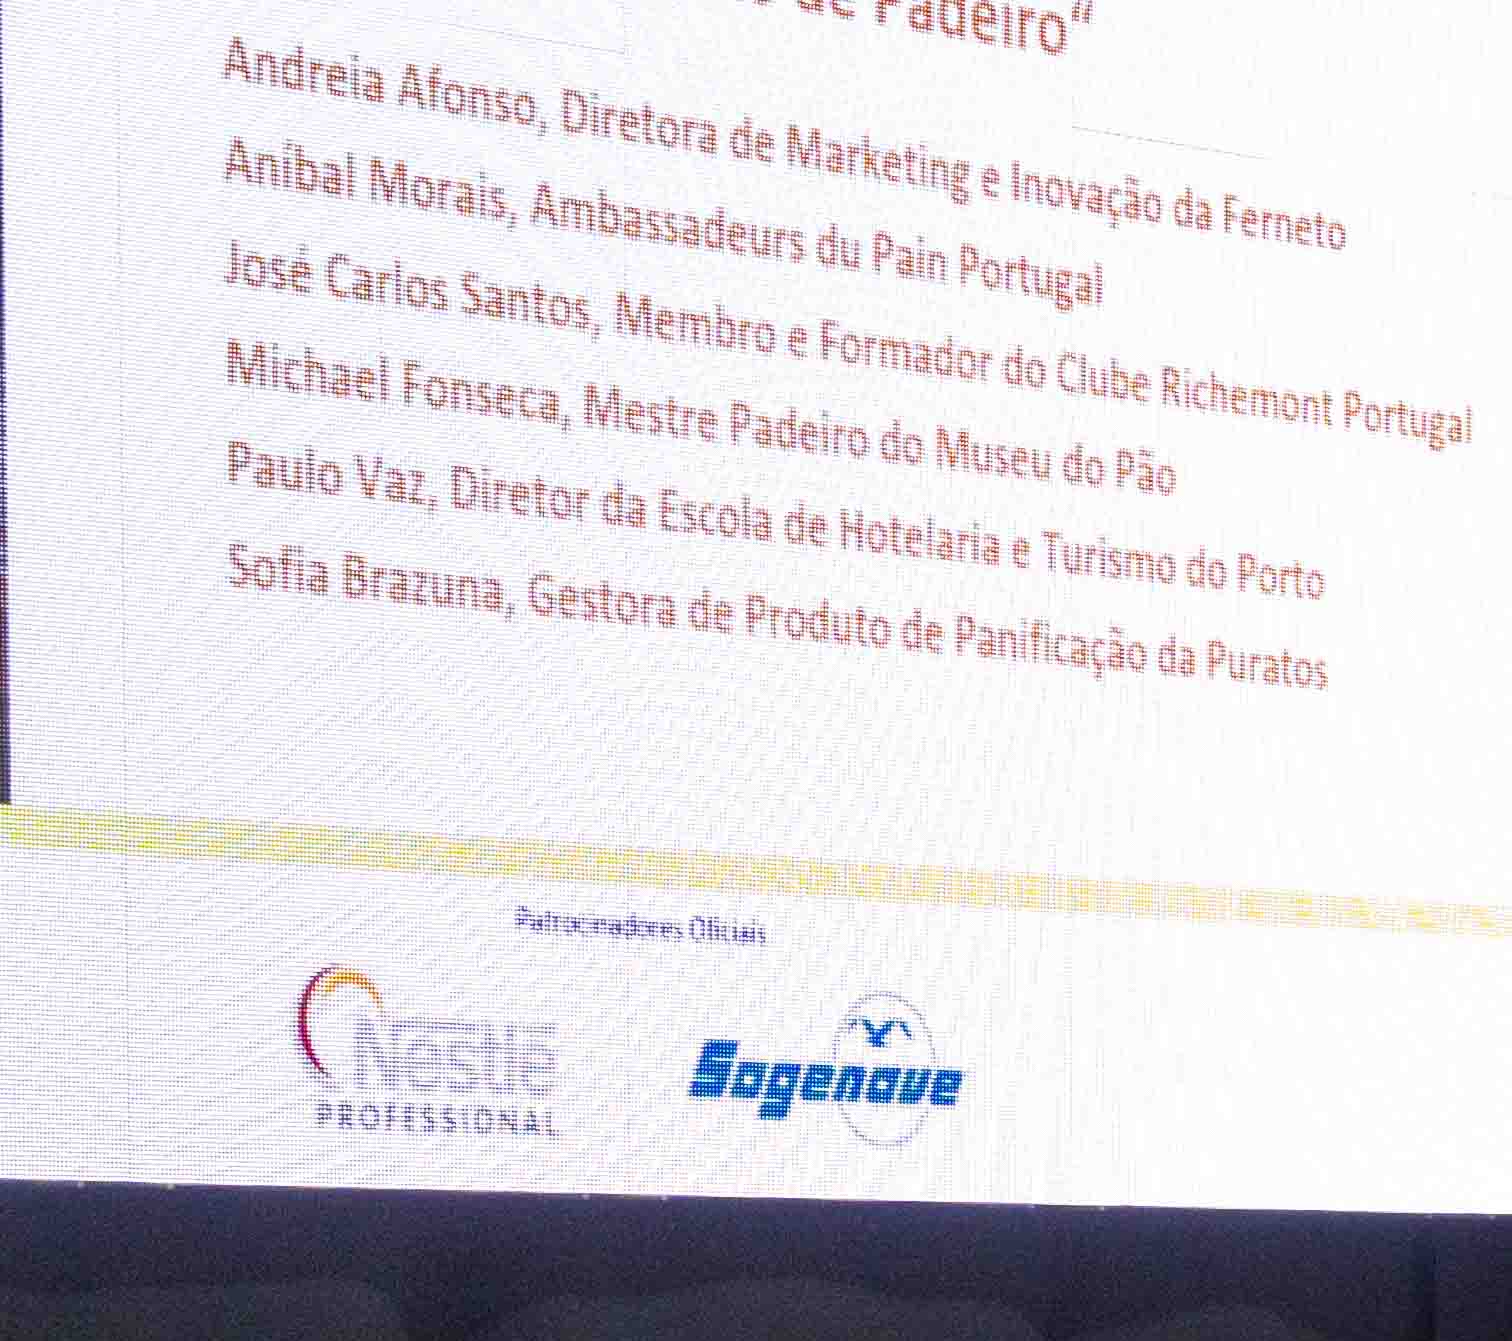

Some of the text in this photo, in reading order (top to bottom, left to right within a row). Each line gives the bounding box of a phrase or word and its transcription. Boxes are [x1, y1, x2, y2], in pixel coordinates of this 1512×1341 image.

[222, 36, 1347, 252] Andreia Afonso, Diretora de Marketing e Inovação da Ferneto
[223, 136, 1104, 313] Aníbal Morais, Ambassadeurs du Pain Portugal
[224, 240, 1474, 452] José Carlos Santos, Membro e Formador do Clube Richemont Portugal
[225, 339, 1176, 497] Michael Fonseca, Mestre Padeiro do Museu do Pão
[228, 440, 1326, 601] Paulo Vaz, Diretor da Escola de Hotelaria e Turismo do Porto
[228, 543, 1329, 691] Sofia Brazuna, Gestora de Produto de Panificação da Puratos
[315, 1099, 561, 1136] PROFESSIONAL
